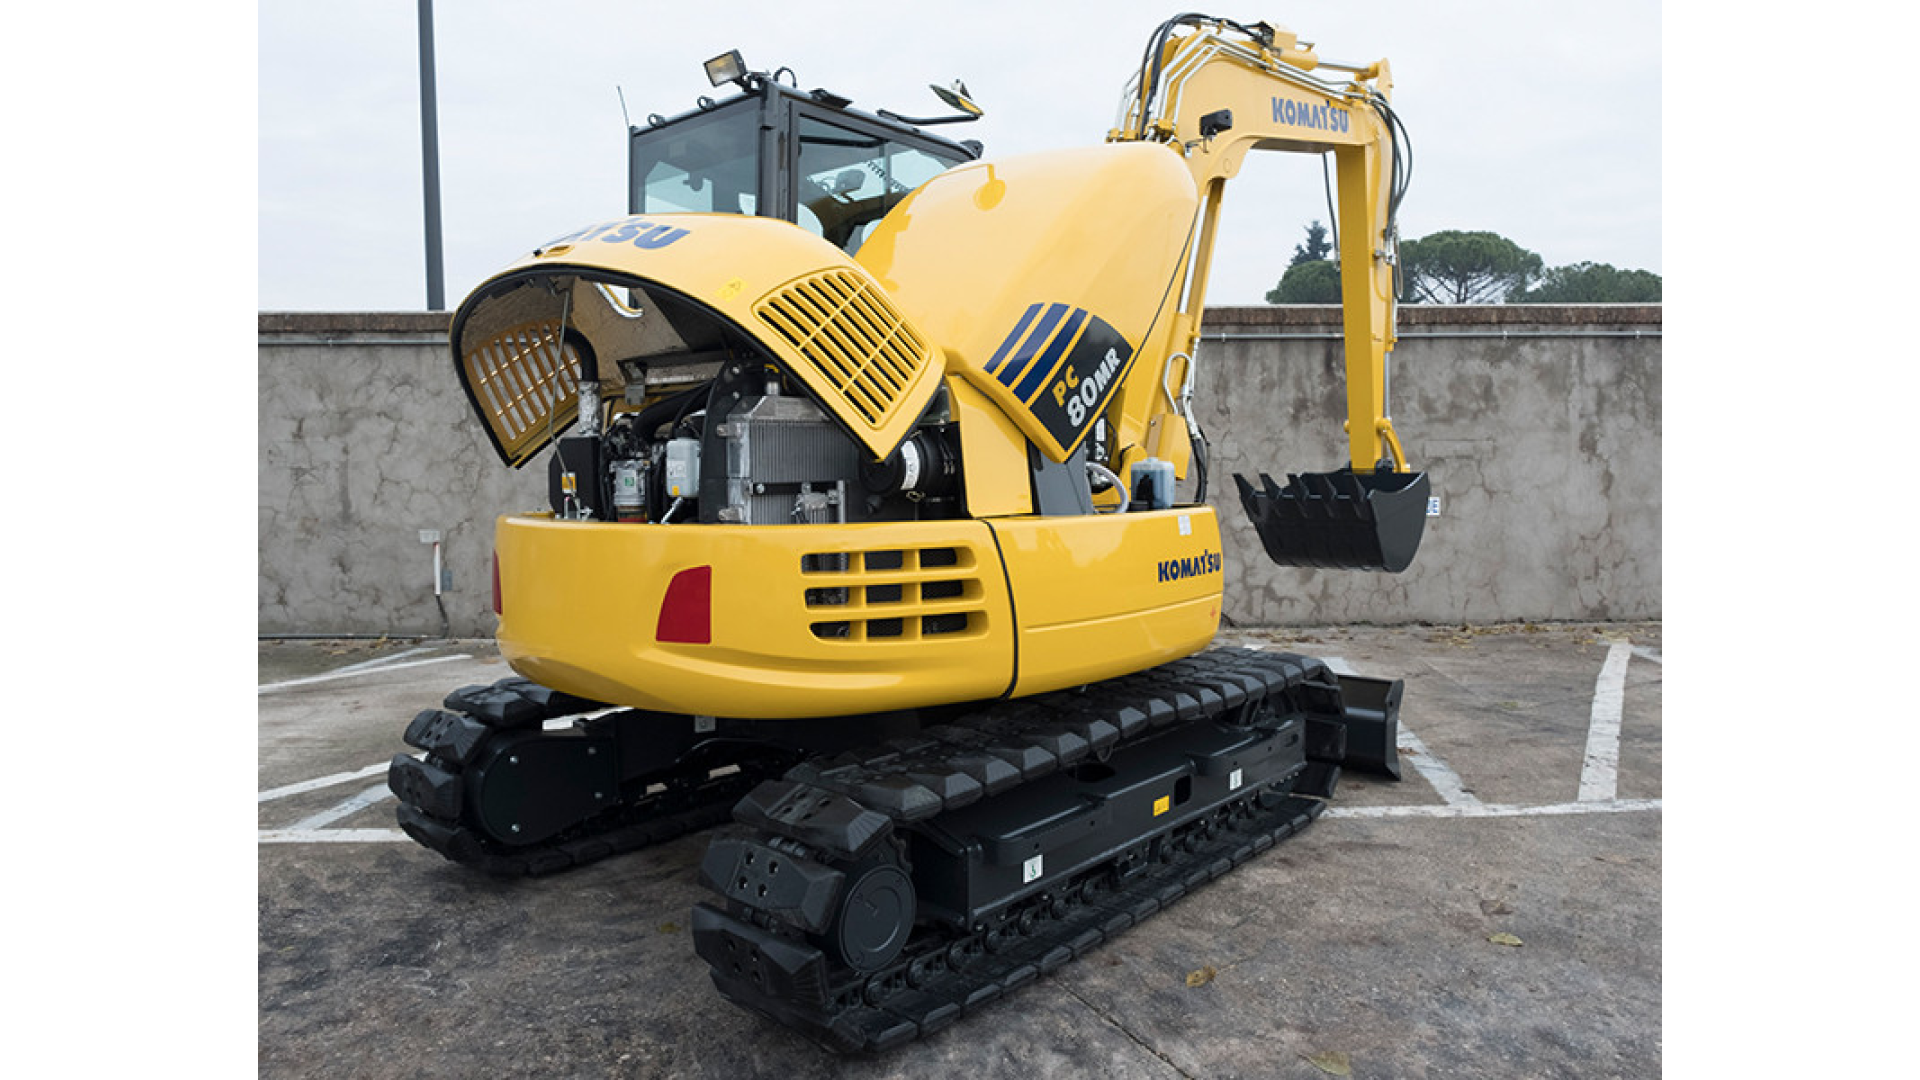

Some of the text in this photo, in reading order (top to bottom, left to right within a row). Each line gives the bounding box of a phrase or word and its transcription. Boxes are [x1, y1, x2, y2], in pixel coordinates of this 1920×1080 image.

[1271, 96, 1349, 133] KOMATSU
[1052, 364, 1079, 408] PC
[1067, 347, 1121, 428] 80MR
[1157, 548, 1222, 583] KOMATSU
